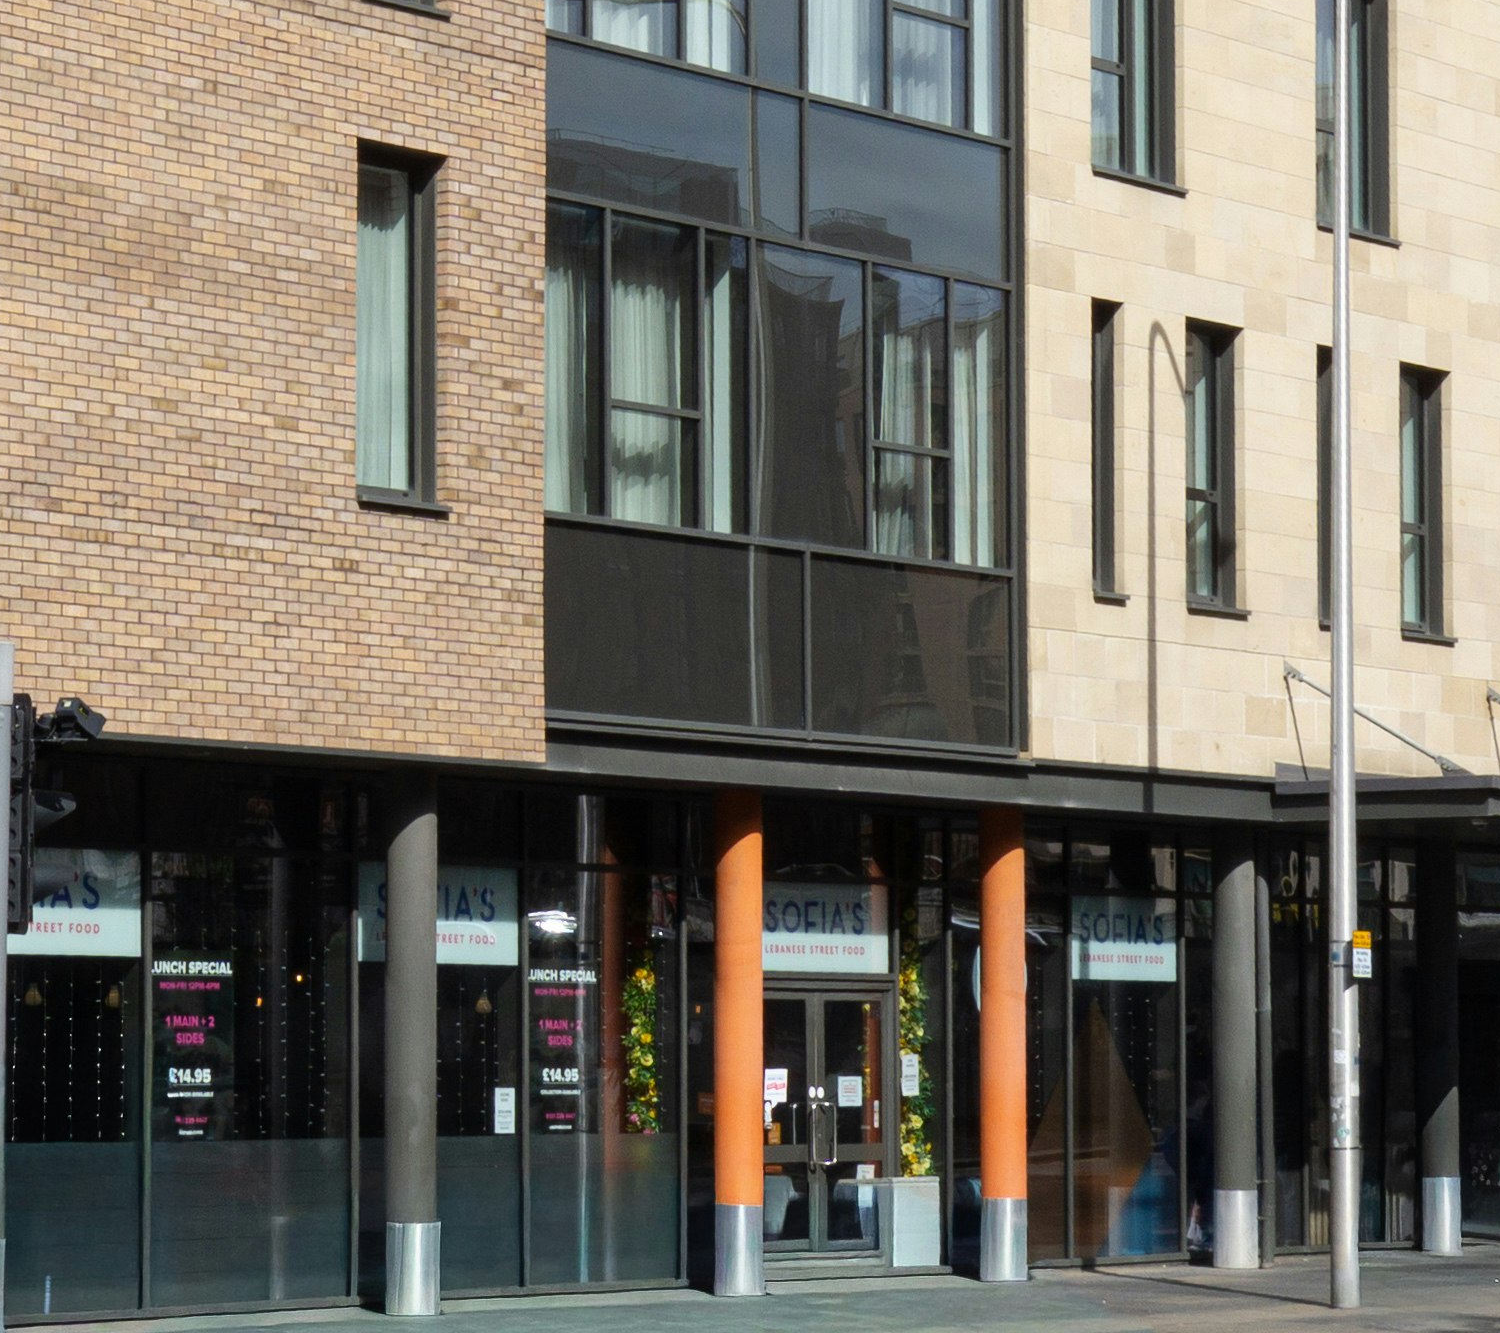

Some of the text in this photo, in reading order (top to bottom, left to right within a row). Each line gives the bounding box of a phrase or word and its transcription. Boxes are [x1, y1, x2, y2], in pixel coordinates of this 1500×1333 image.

[765, 899, 865, 935] SOFIA'S
[29, 921, 101, 934] TREET FOOD
[1080, 912, 1164, 945] SOFIA'S
[437, 934, 465, 944] TREET
[765, 943, 866, 956] LEBANESE STREET FOOD
[1117, 954, 1142, 964] STREET
[1145, 955, 1165, 965] FOOD
[188, 961, 233, 974] SPECIAL
[559, 969, 597, 982] SPECIAL
[165, 1016, 171, 1027] 1
[173, 1016, 199, 1027] MAIN
[208, 1016, 215, 1027] 2
[545, 1019, 568, 1030] MAIN
[176, 1033, 205, 1044] SIDES
[547, 1035, 573, 1046] SIDES
[168, 1067, 212, 1083] £14.95
[542, 1068, 579, 1083] £14.95
